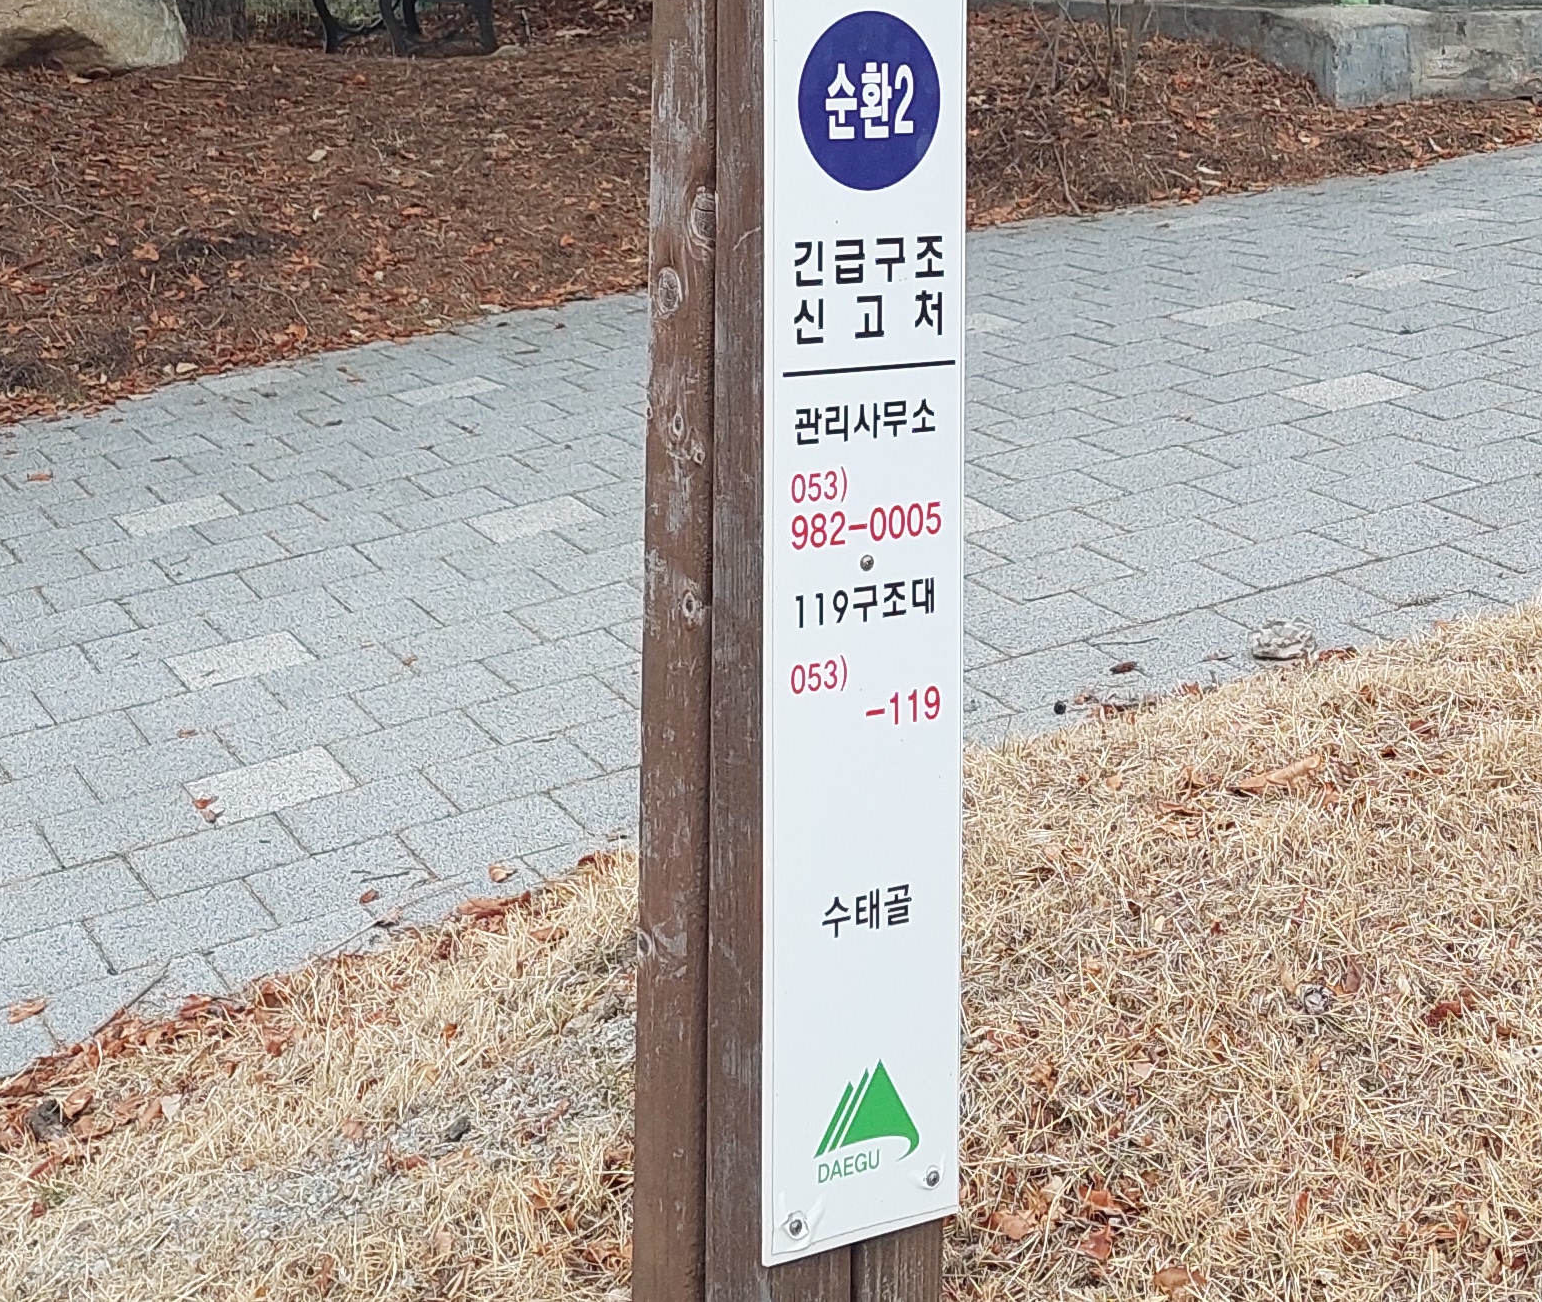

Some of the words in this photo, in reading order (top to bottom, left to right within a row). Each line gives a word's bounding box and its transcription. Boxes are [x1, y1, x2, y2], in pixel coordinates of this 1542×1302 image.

[825, 61, 915, 140] 순환2
[793, 235, 945, 287] 긴급구조
[794, 398, 936, 446] 관리사무소
[791, 466, 848, 504] 053)
[791, 501, 942, 550] 982-0005
[795, 577, 936, 629] 119구조대
[790, 655, 848, 695] 053)
[865, 685, 941, 726] -119
[821, 883, 912, 939] 수태골
[817, 1149, 881, 1184] DAEGU
